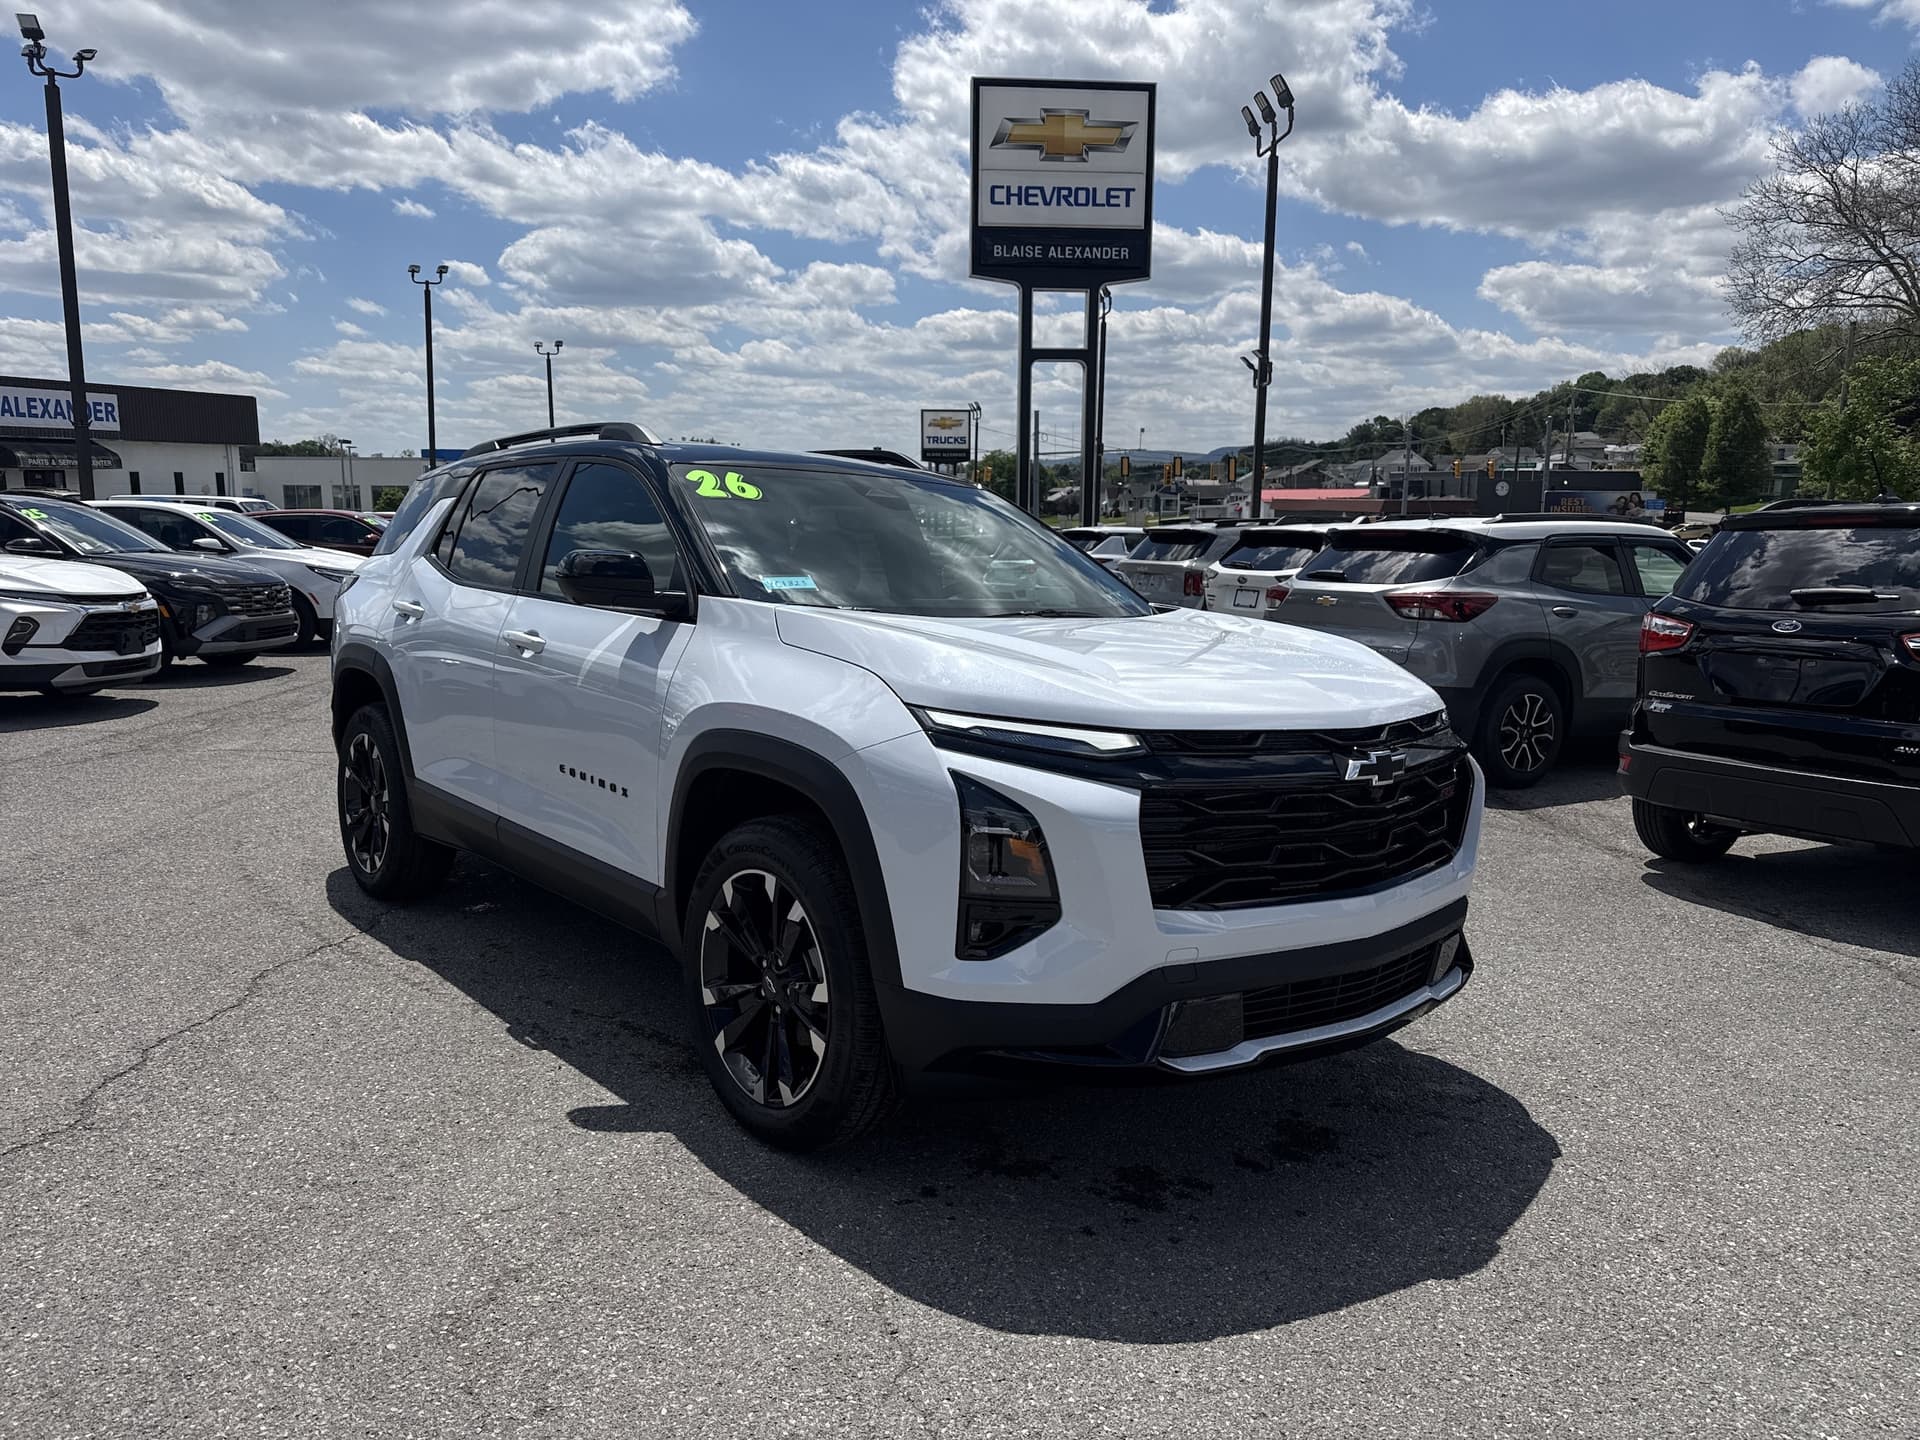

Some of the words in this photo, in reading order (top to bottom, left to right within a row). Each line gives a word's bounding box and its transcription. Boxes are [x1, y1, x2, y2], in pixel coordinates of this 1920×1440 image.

[990, 185, 1136, 208] CHEVROLET
[993, 244, 1043, 258] BLAISE
[1048, 246, 1129, 260] ALEXANDER
[0, 395, 118, 422] ALEXAER
[926, 436, 967, 445] TRUCKS
[685, 469, 763, 500] 26
[1893, 745, 1920, 754] 4W
[559, 763, 628, 798] EQUINOX
